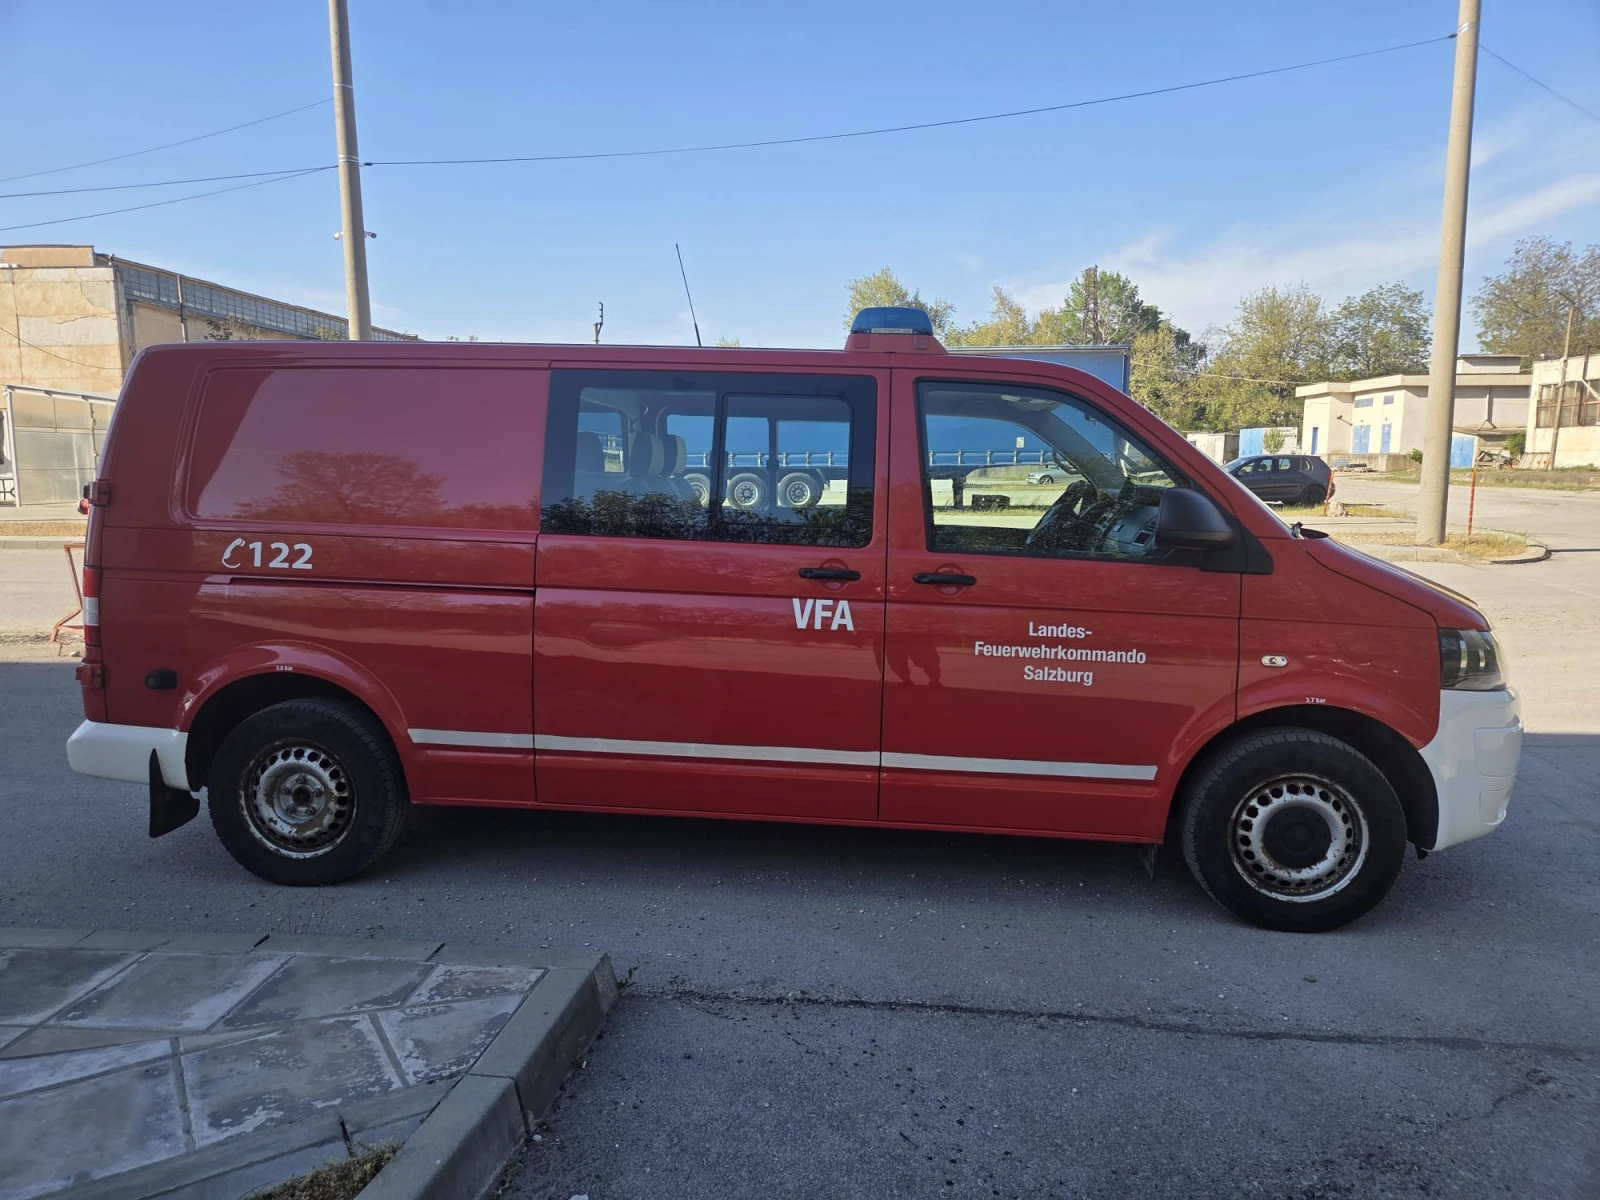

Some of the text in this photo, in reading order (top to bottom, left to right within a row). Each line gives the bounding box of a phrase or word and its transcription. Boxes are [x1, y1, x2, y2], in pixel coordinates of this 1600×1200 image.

[249, 541, 313, 570] 122
[792, 598, 855, 632] VFA
[1028, 621, 1093, 639] Landes-
[974, 641, 1147, 664] Feuerwehrkommando
[1023, 665, 1094, 687] Salzburg
